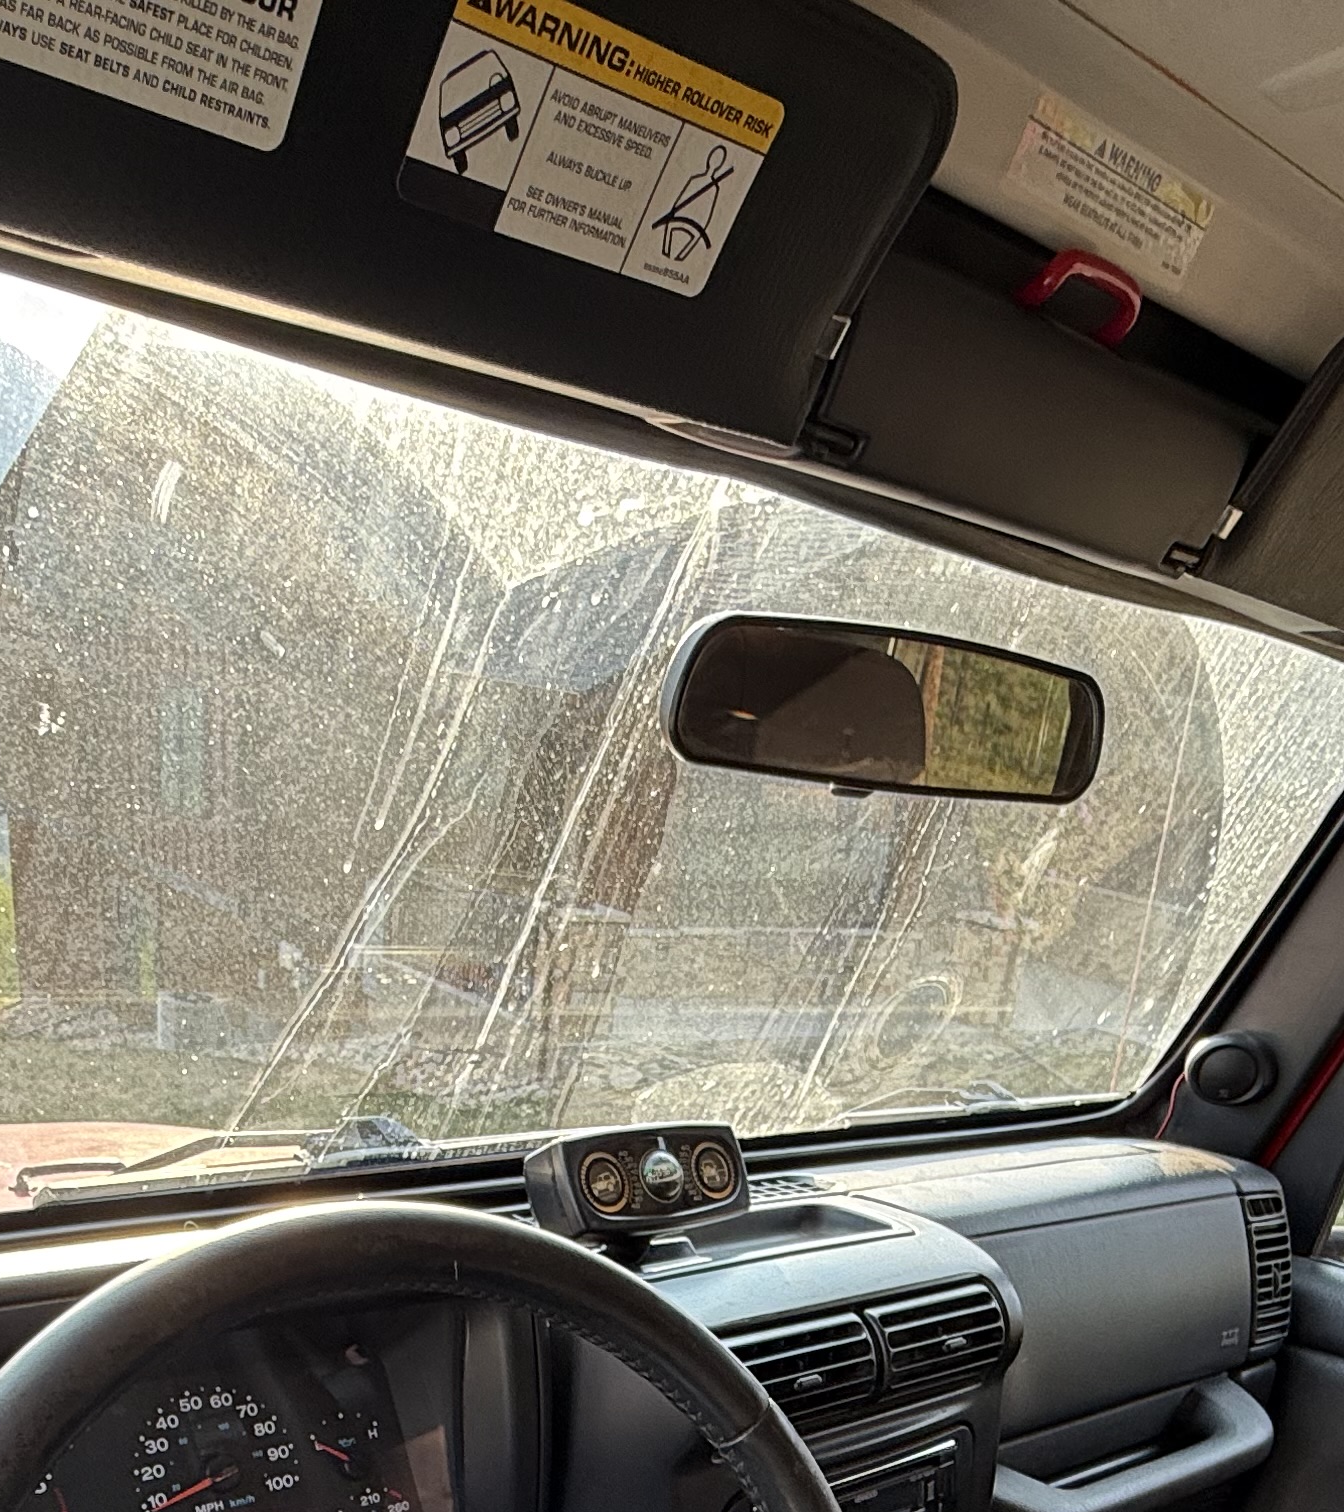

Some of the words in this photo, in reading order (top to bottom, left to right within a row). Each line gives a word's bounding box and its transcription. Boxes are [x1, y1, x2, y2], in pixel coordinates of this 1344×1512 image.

[129, 0, 175, 23] SAFEST
[176, 13, 214, 39] PLACE
[215, 28, 238, 49] FOR
[219, 6, 236, 23] BY
[237, 12, 257, 33] THE
[257, 23, 277, 40] AIR
[69, 0, 147, 37] REAR-FACING
[149, 27, 184, 51] CHILD
[185, 41, 215, 62] SEAT
[215, 53, 229, 69] IN
[231, 58, 252, 78] THE
[20, 1, 45, 23] FAR
[47, 12, 81, 37] BACK
[83, 26, 101, 44] AS
[103, 33, 159, 65] POSSIBLE
[160, 55, 194, 78] FROM
[197, 67, 219, 88] THE
[219, 78, 239, 96] AIR
[31, 31, 56, 52] USE
[59, 41, 91, 63] SEAT
[93, 53, 130, 78] BELTS
[132, 69, 160, 89] AND
[162, 79, 197, 102] CHILD
[199, 93, 270, 129] RESTRAINTS.
[633, 64, 682, 98] HIGHER
[681, 86, 743, 125] ROLLOVER
[743, 114, 774, 138] RISK
[550, 89, 580, 111] AVOID
[579, 101, 618, 125] ABRUPT
[617, 116, 671, 148] MANEUVERS
[553, 110, 577, 129] AND
[576, 119, 625, 148] EXCESSIVE
[546, 151, 584, 175] ALWAYS
[584, 165, 619, 188] BUCKLE
[506, 197, 527, 214] FOR
[527, 204, 569, 228] FURTHER
[525, 185, 545, 202] SEE
[544, 192, 587, 217] OWNER'S
[587, 207, 623, 230] MANUAL
[178, 1396, 203, 1413] 50
[209, 1392, 233, 1409] 60
[235, 1402, 259, 1419] 70
[155, 1414, 180, 1431] 40
[253, 1420, 276, 1437] 80
[367, 1428, 379, 1440] H
[144, 1437, 169, 1455] 30
[267, 1445, 289, 1462] 90
[141, 1463, 166, 1482] 20
[265, 1474, 294, 1492] 100
[147, 1491, 168, 1509] 10
[228, 1494, 256, 1508] km/h
[359, 1492, 381, 1507] 210
